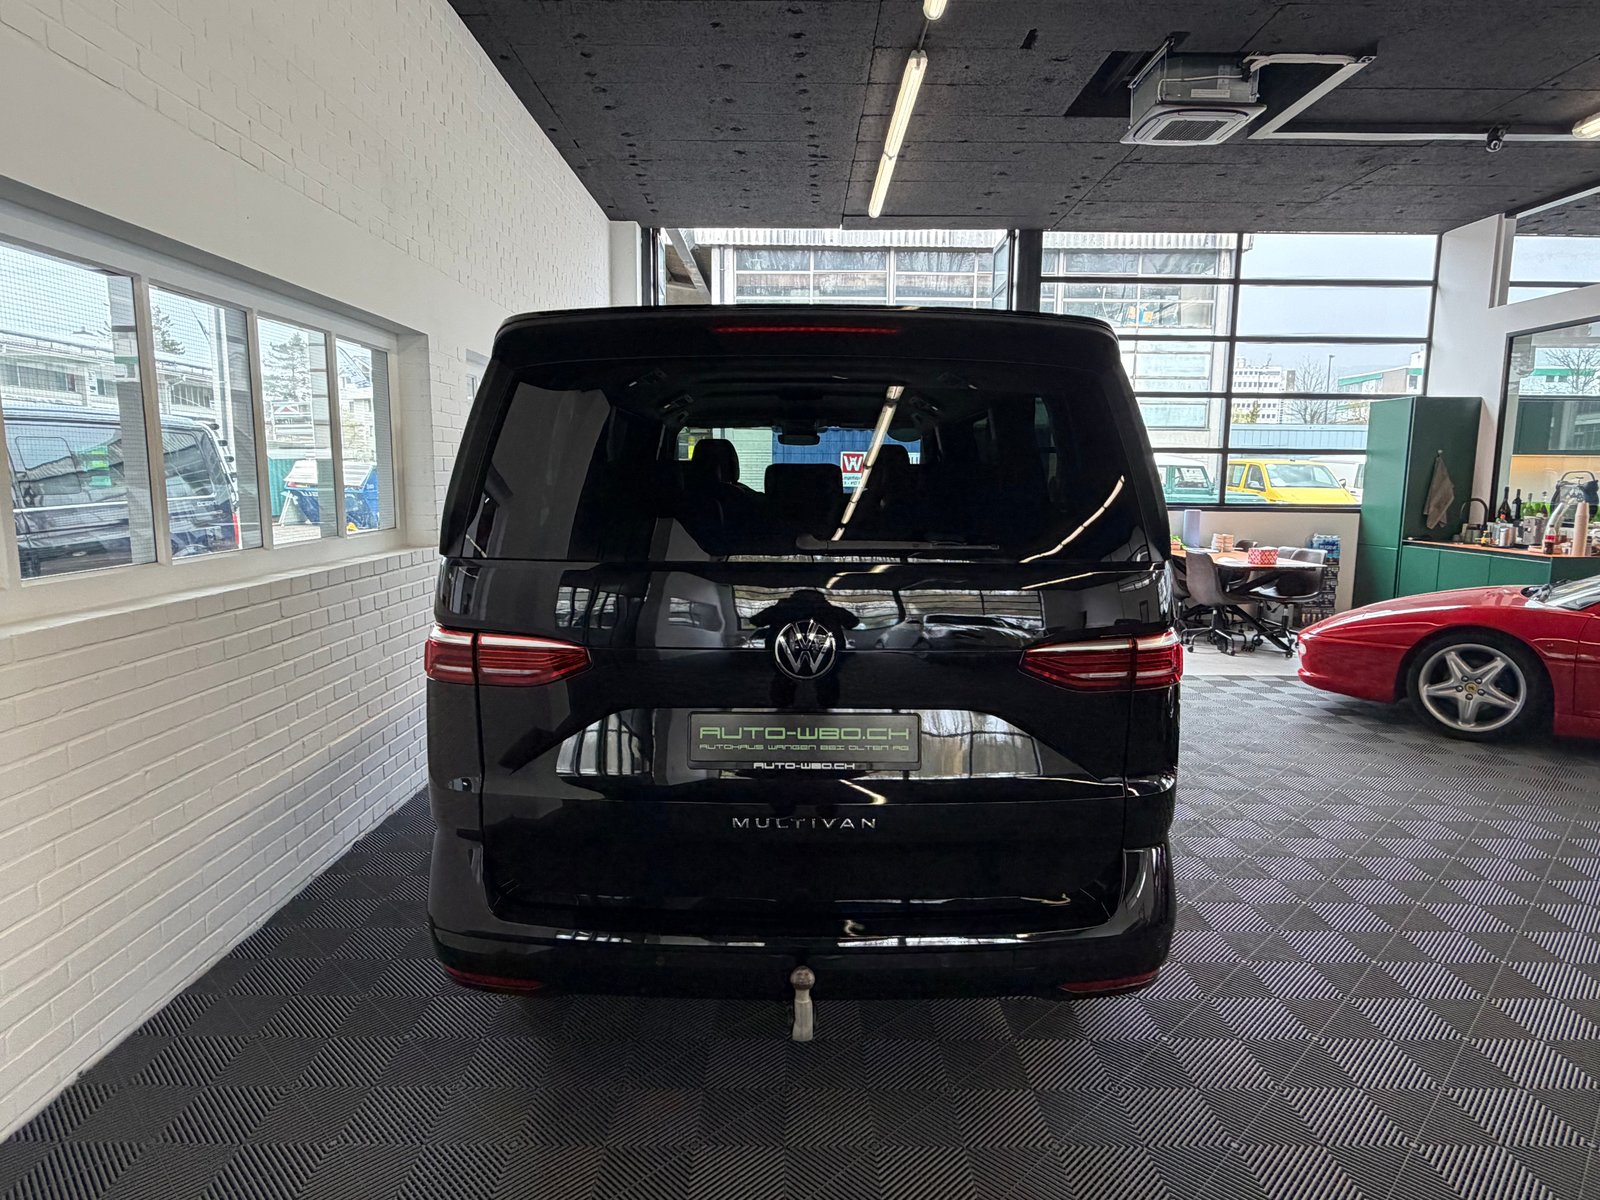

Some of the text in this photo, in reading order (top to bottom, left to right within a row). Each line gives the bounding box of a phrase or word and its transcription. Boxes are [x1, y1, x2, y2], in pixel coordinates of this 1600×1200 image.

[699, 726, 910, 740] AUTO-WBO.CH
[699, 743, 764, 751] AUTOHAUS
[767, 743, 817, 751] WANGEN
[753, 762, 856, 770] AUTO-WBO.CH
[732, 817, 876, 829] MULTIVAN
